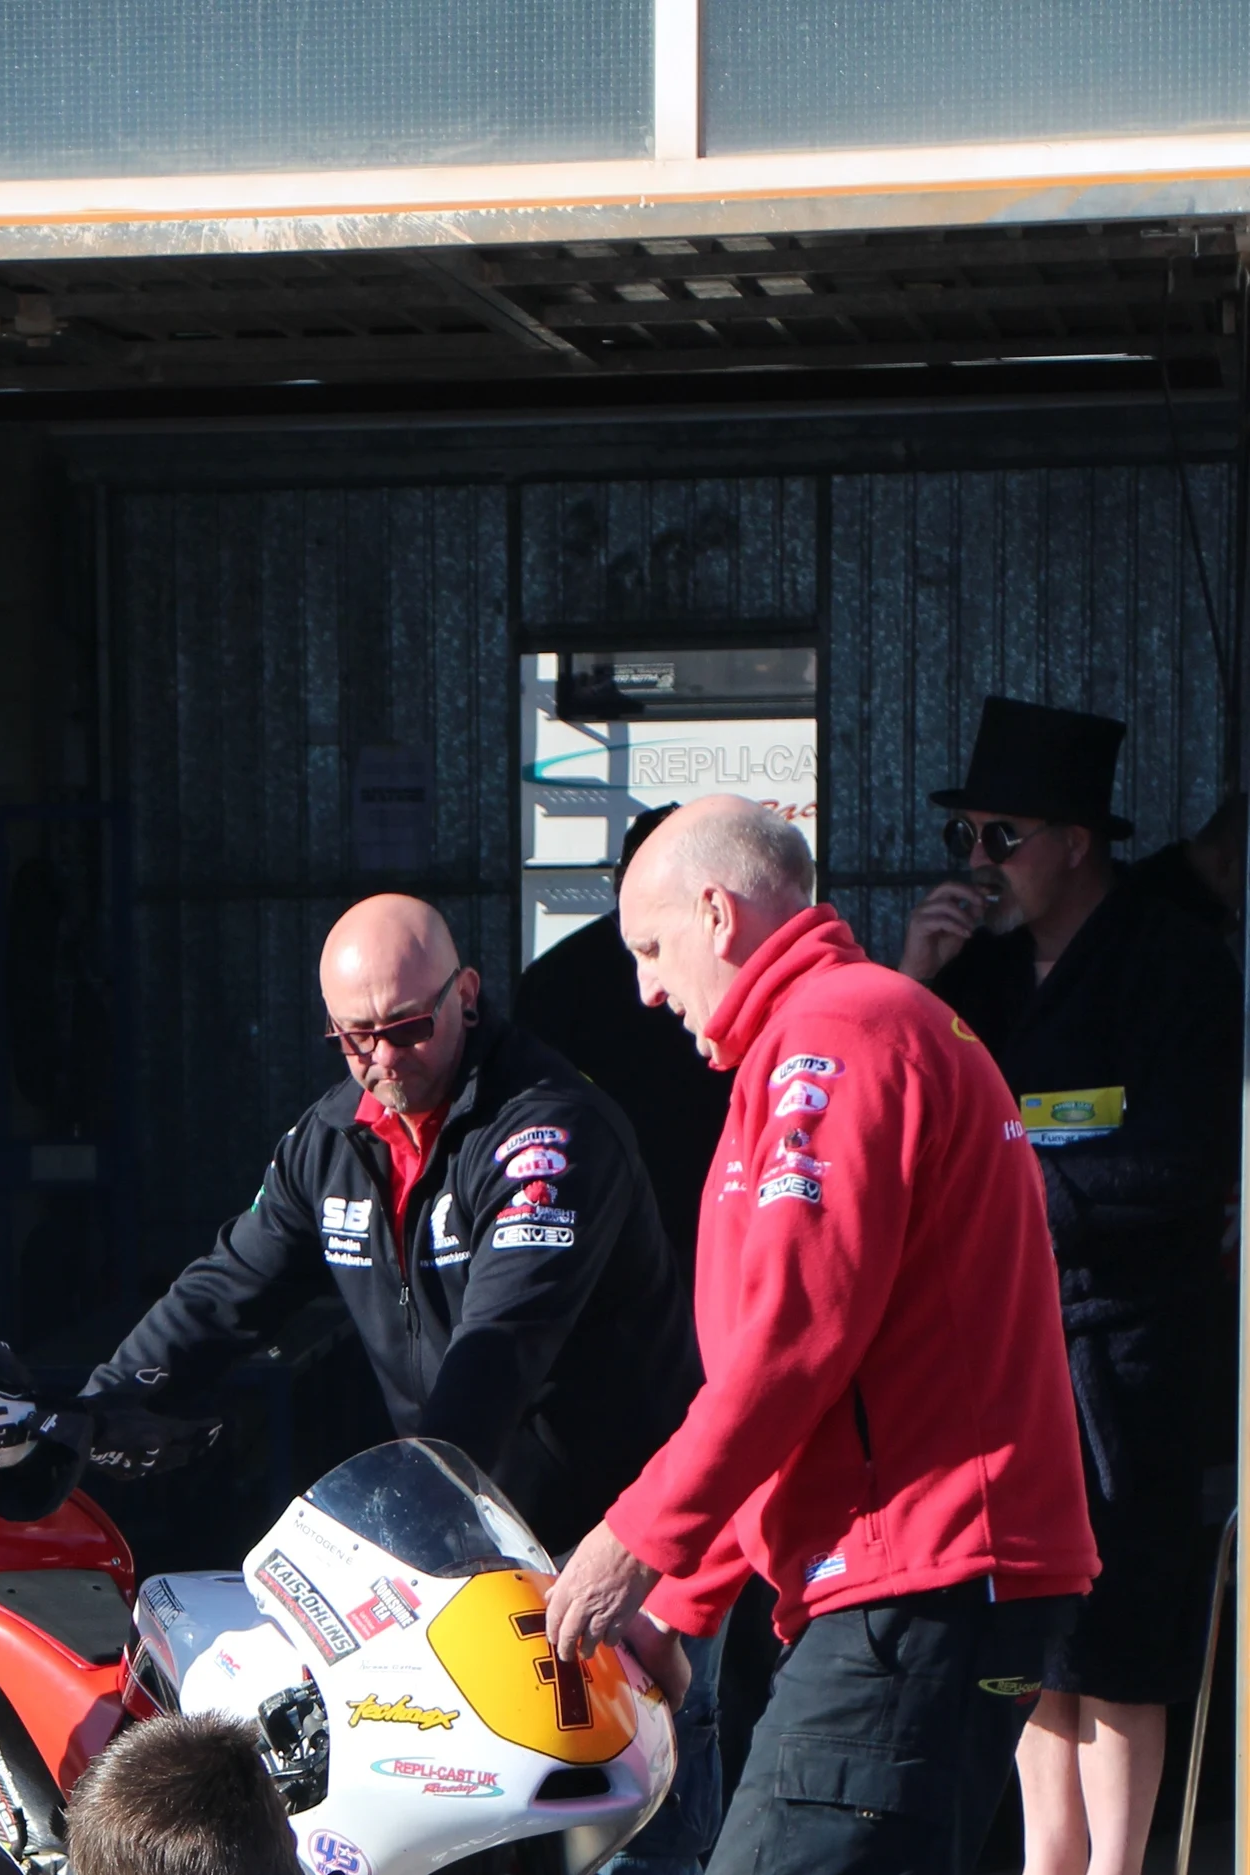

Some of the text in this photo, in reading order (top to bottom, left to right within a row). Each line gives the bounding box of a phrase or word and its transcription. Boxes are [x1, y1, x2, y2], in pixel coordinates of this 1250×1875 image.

[498, 1227, 569, 1245] JENVEY
[372, 1601, 392, 1622] TEA
[373, 1577, 416, 1628] YORKSHIRE
[393, 1760, 499, 1786] REPLI-CAST UK
[315, 1833, 362, 1872] 45
